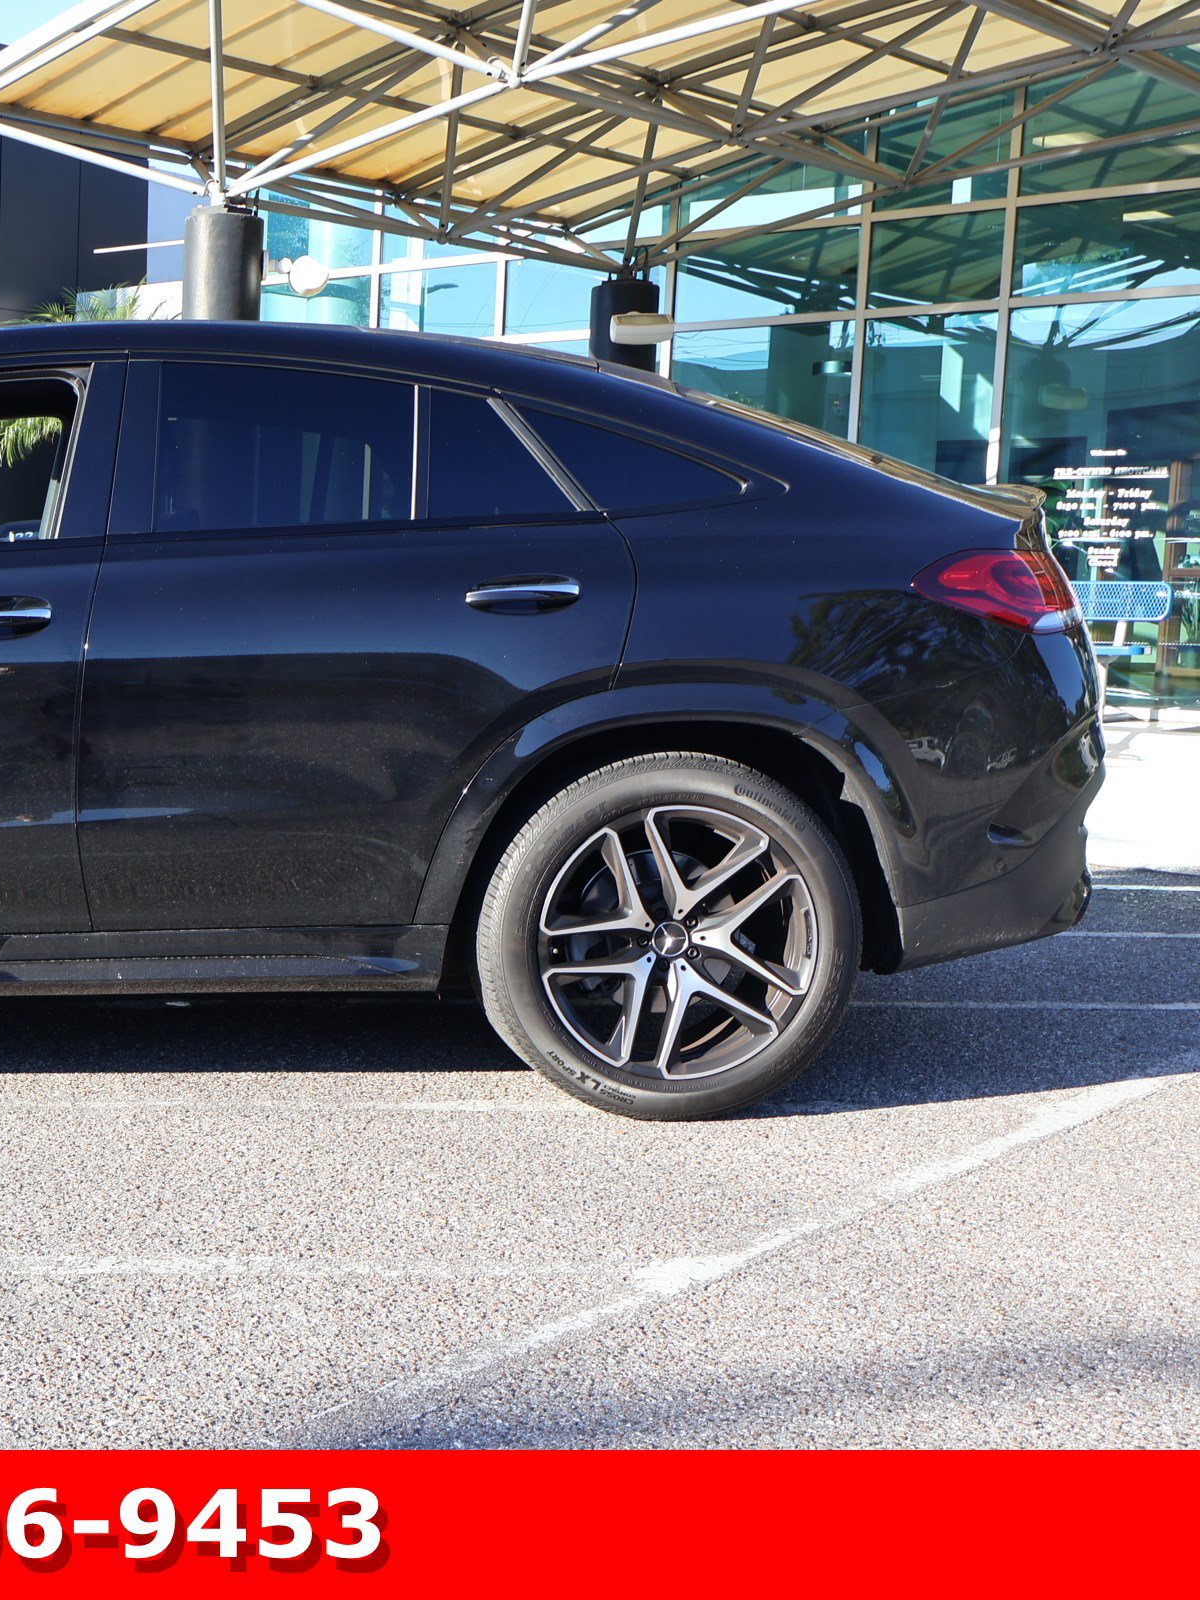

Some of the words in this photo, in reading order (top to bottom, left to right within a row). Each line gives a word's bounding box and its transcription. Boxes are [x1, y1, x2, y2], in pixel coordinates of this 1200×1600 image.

[1066, 489, 1105, 498] Monday
[1117, 488, 1152, 499] Friday
[1112, 501, 1137, 511] 7:00
[1084, 516, 1129, 527] Saturday
[1087, 546, 1121, 555] Sunday
[546, 1050, 577, 1077] SPORT
[576, 1070, 602, 1091] LX
[600, 1088, 635, 1106] CROSS
